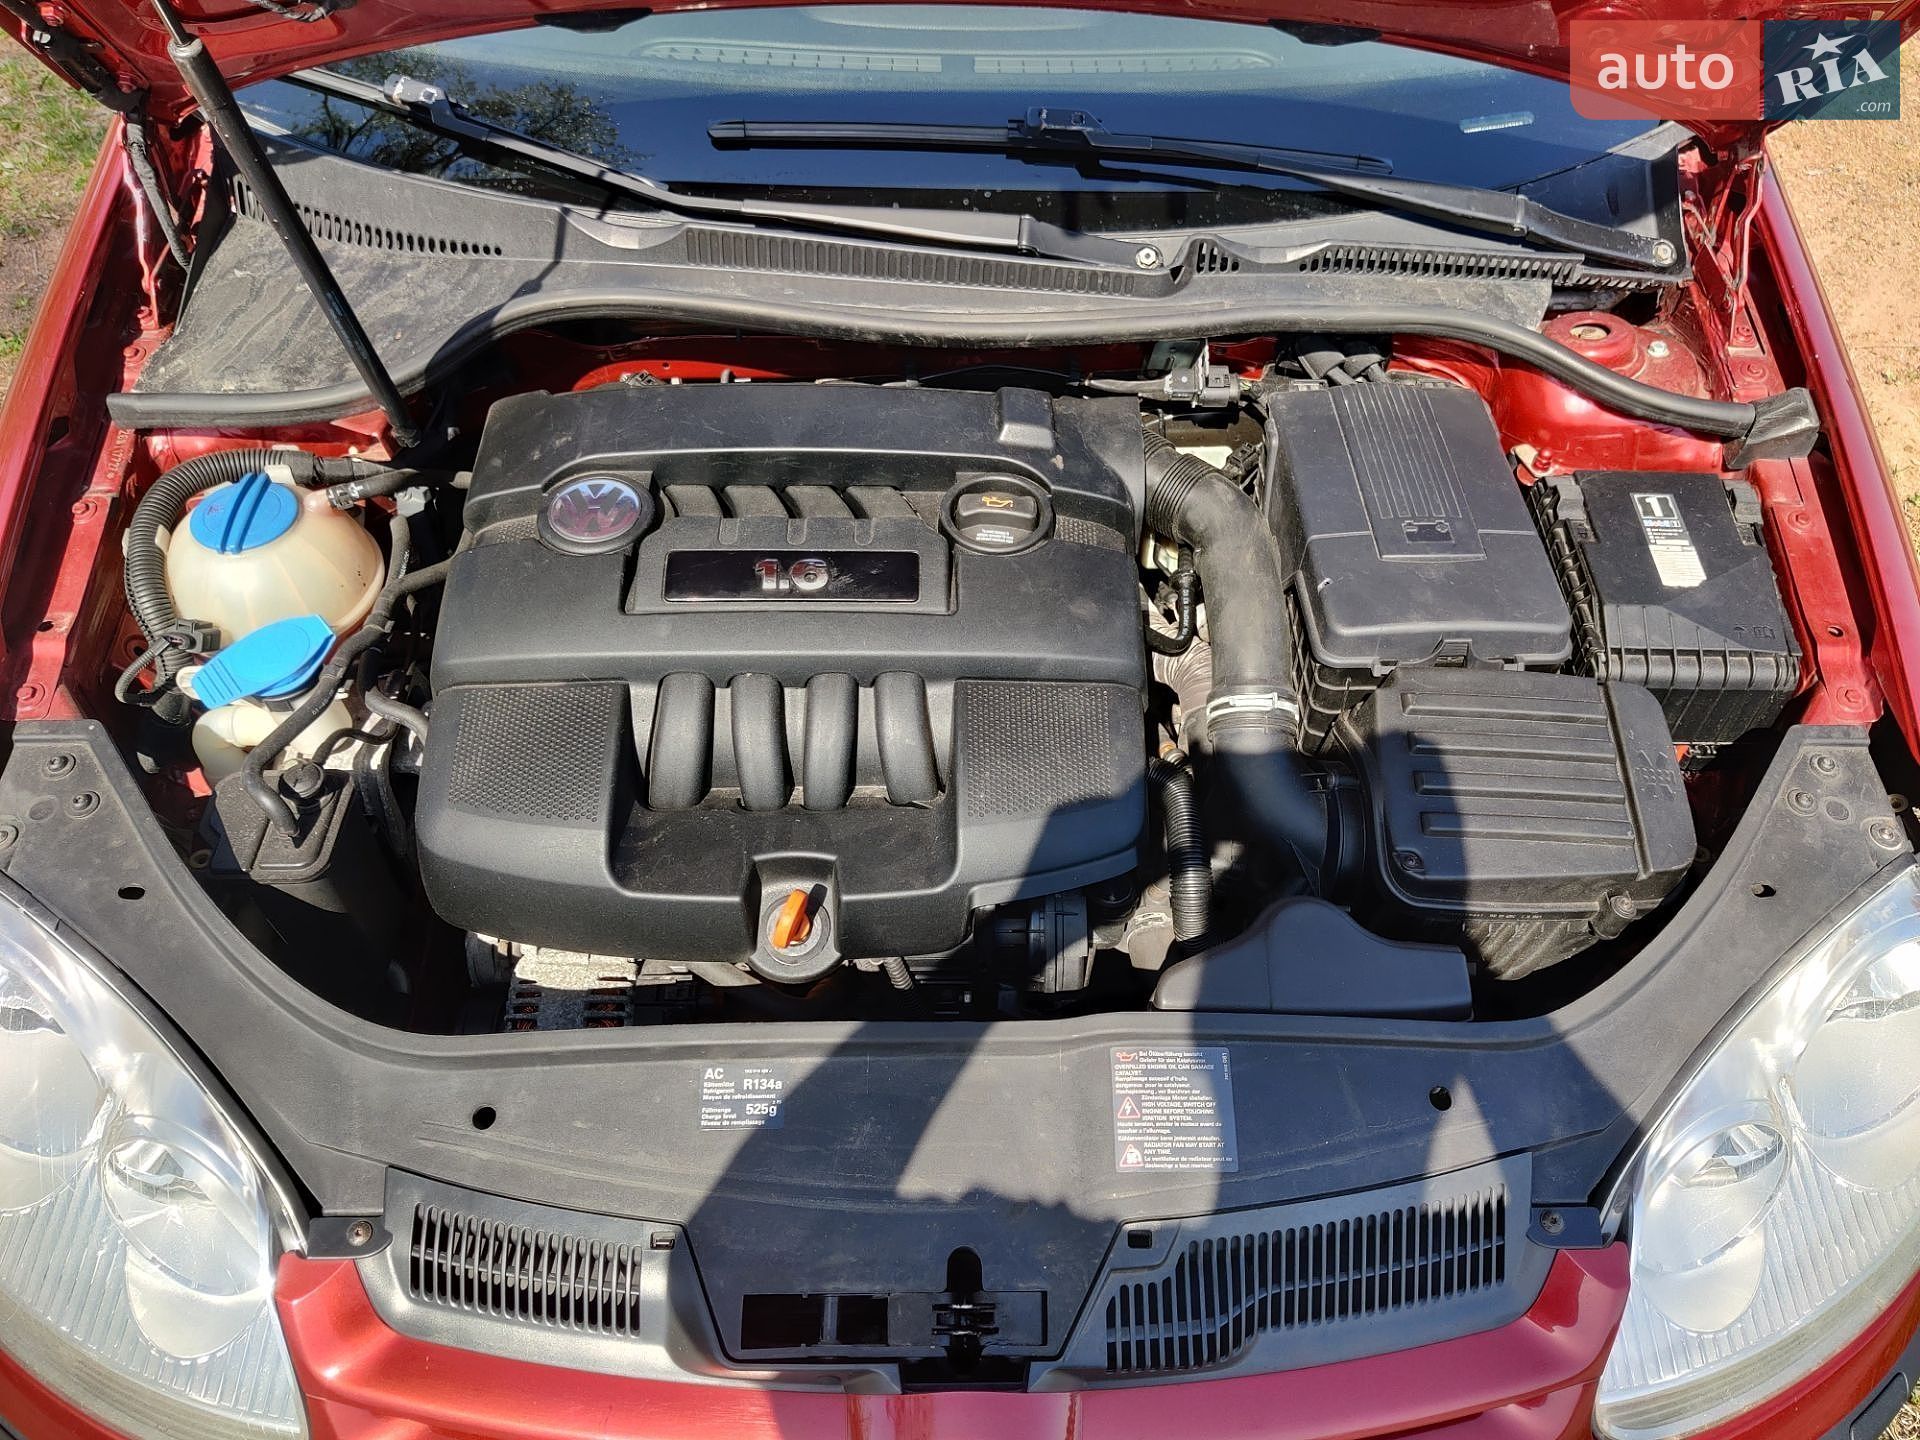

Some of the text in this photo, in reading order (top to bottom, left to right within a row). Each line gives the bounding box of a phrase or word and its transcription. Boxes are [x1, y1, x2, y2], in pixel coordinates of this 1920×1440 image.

[753, 558, 829, 590] 1.6
[704, 1068, 724, 1080] AC
[743, 1079, 782, 1090] R134a
[745, 1103, 777, 1117] 525g
